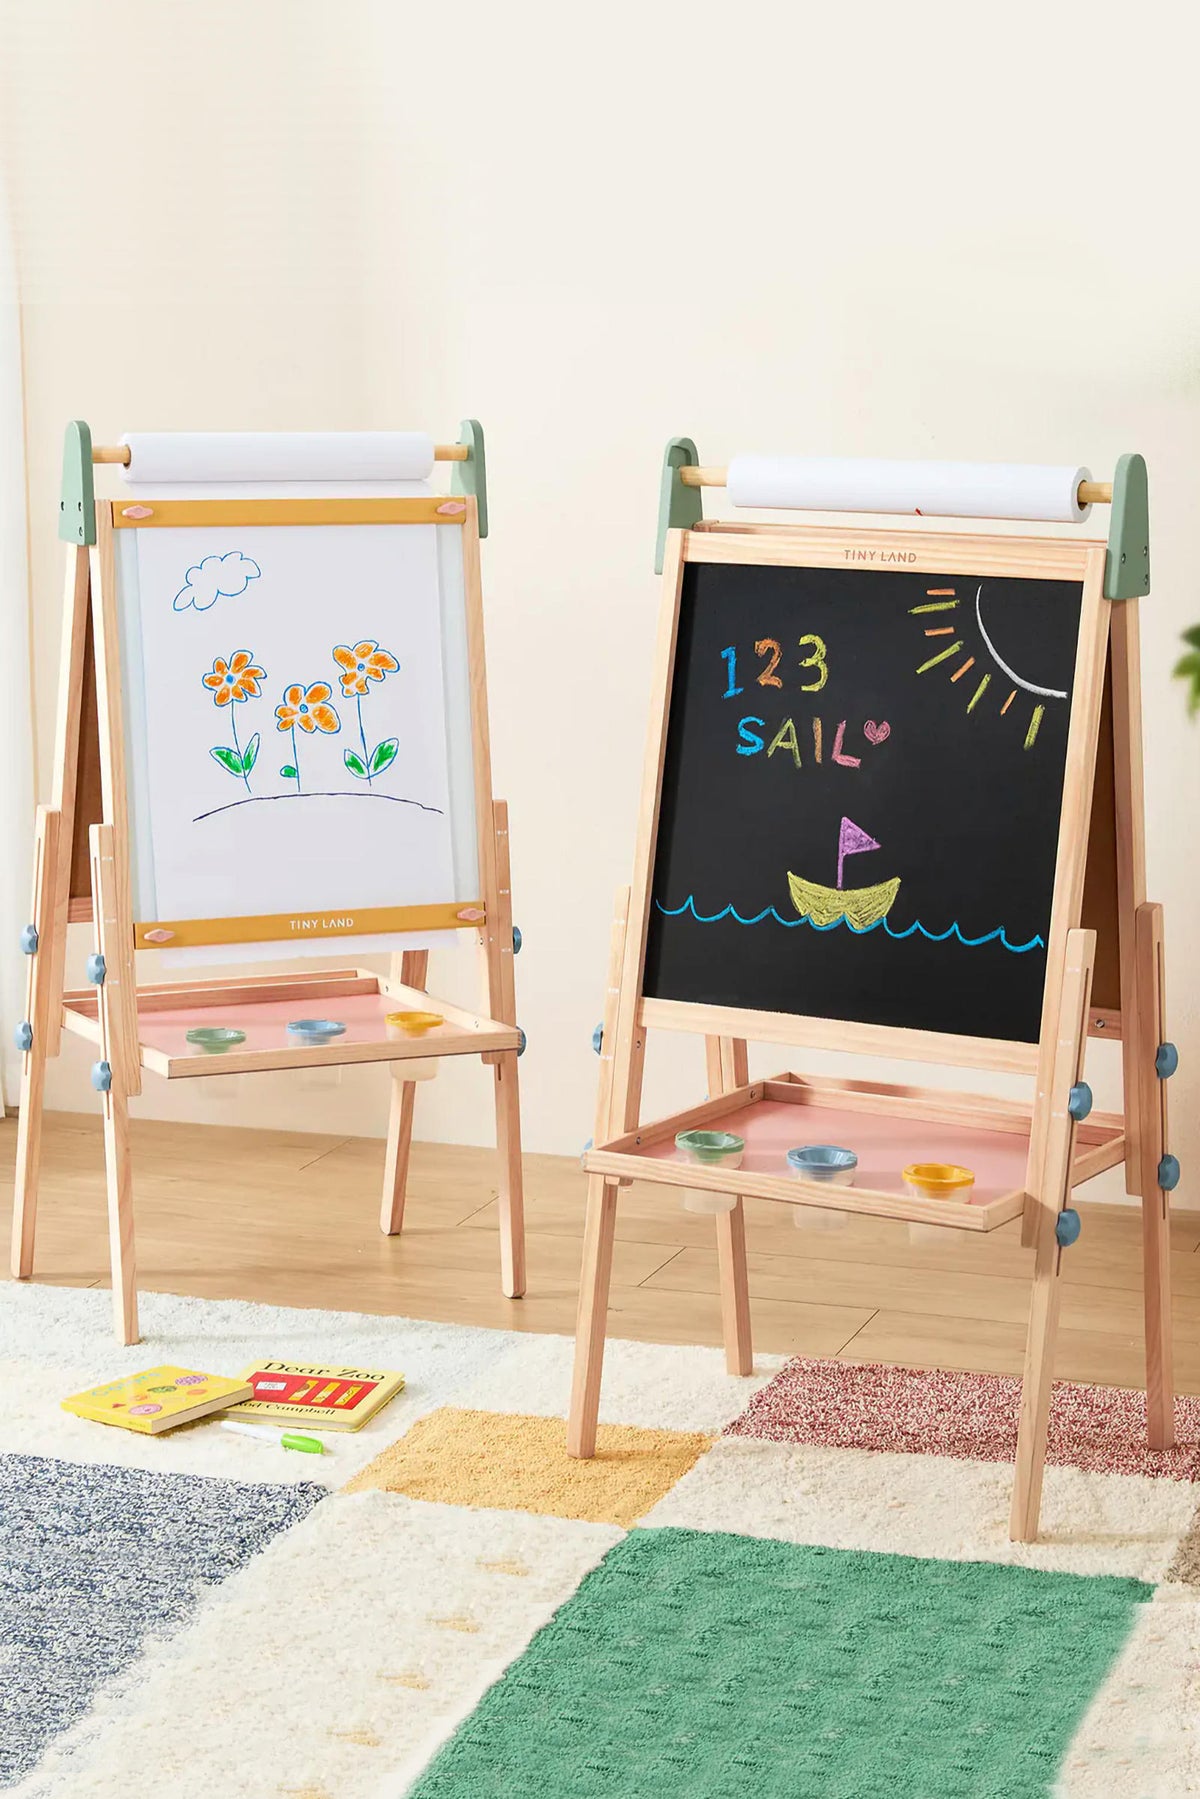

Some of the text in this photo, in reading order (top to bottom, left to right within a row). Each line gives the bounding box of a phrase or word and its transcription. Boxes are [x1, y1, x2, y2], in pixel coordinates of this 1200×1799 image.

[844, 549, 917, 563] TINY LAND
[736, 716, 861, 768] SAIL
[289, 917, 354, 931] TINY LAND
[263, 1361, 385, 1381] Dear Zoo
[266, 1403, 335, 1415] Campbell
